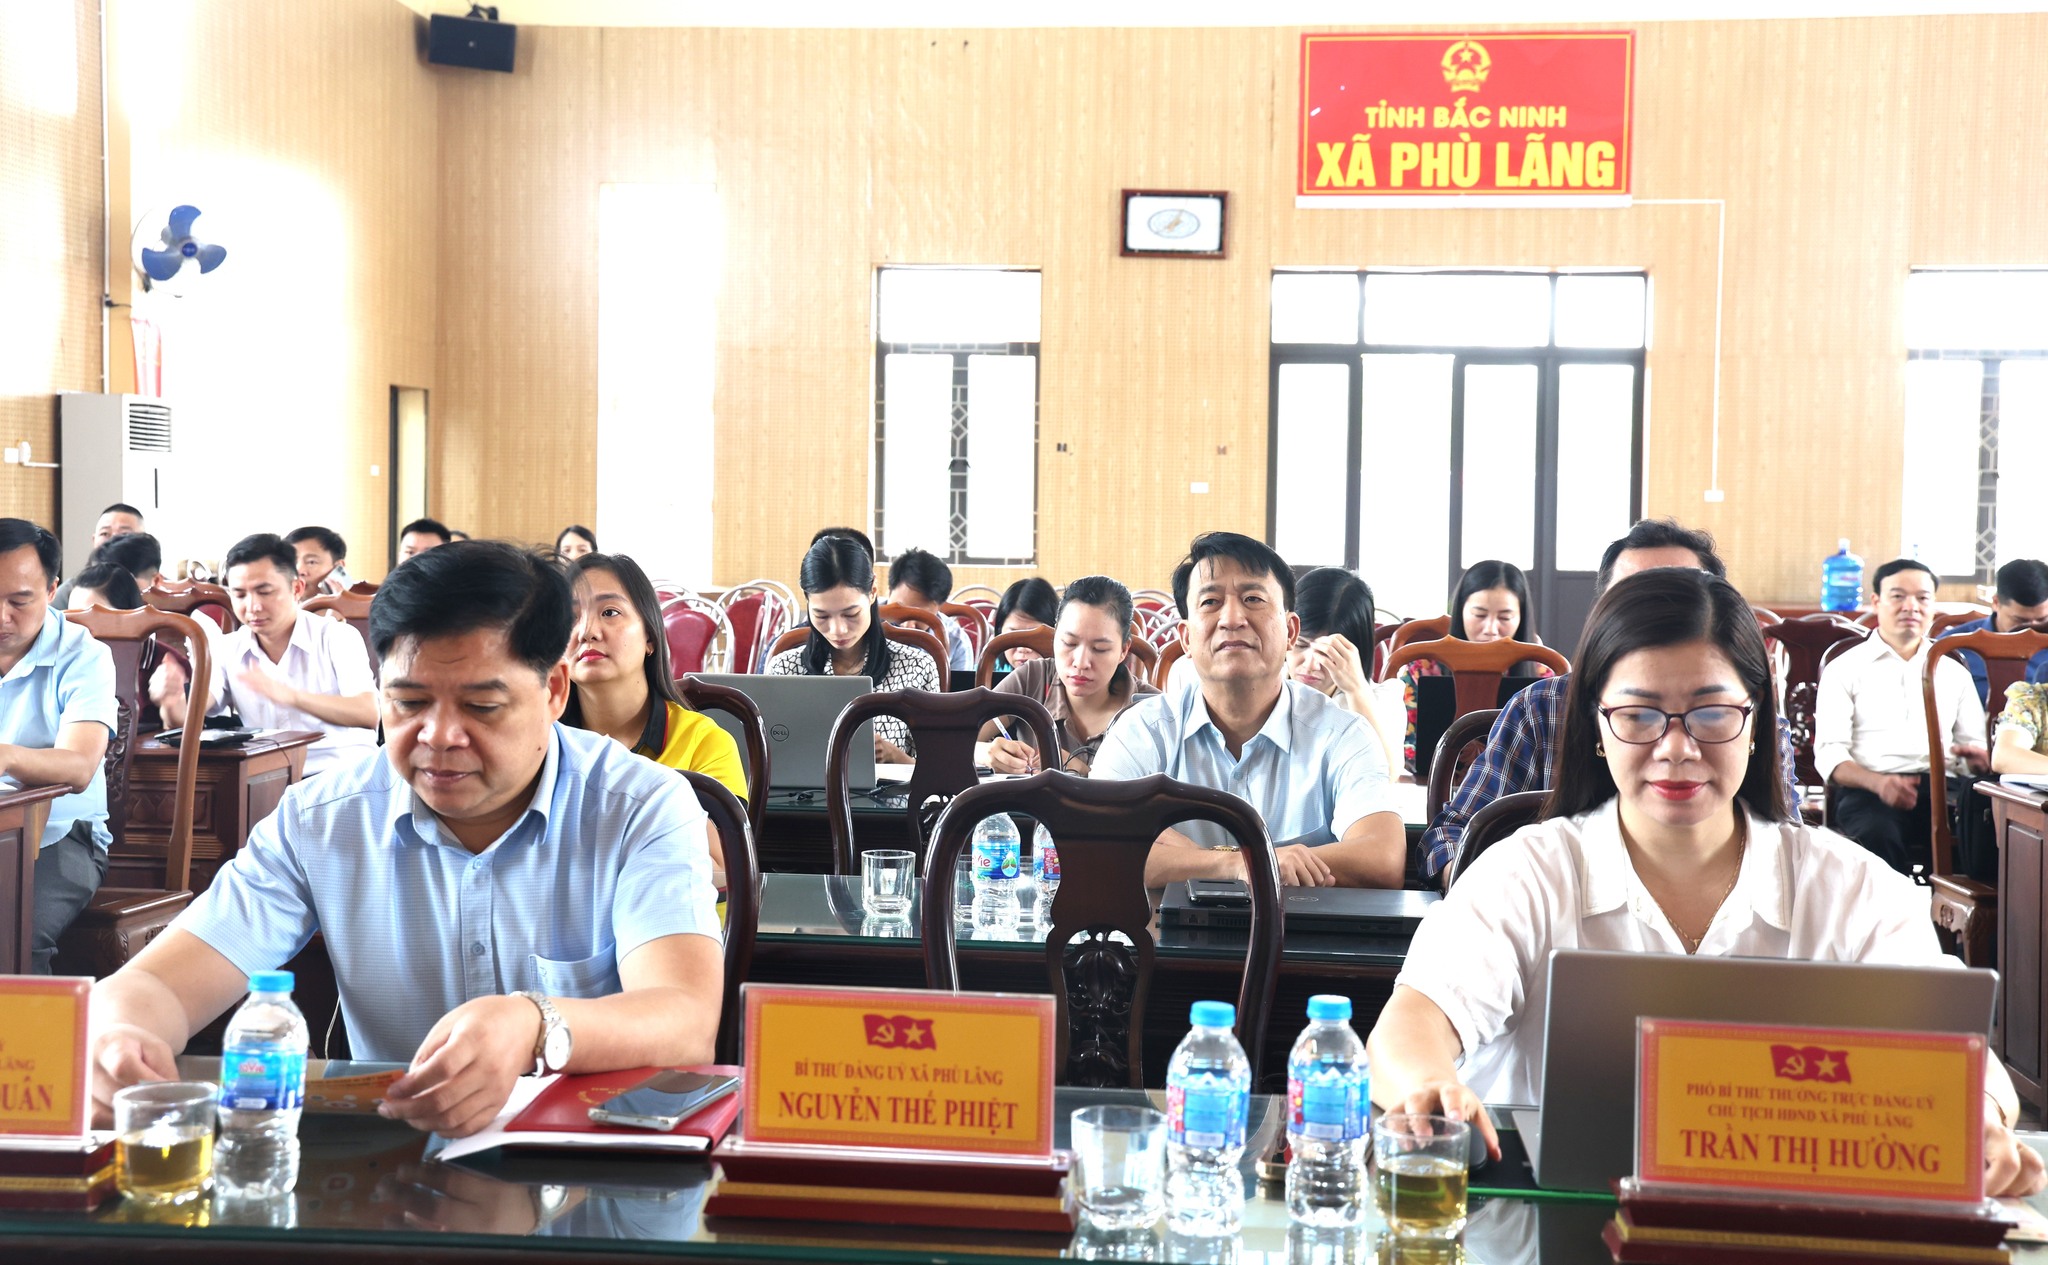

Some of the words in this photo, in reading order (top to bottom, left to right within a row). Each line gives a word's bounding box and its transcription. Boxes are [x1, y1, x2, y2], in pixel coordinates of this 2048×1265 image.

[1365, 99, 1425, 128] TỈNH
[1433, 96, 1491, 128] BẮC
[1499, 106, 1567, 128] NINH
[1315, 133, 1376, 187] XÃ
[1390, 132, 1481, 187] PHÙ
[1495, 132, 1616, 187] LÃNG
[795, 1058, 808, 1077] BÍ
[812, 1060, 842, 1078] THƯ
[910, 1063, 929, 1082] XÃ
[0, 1076, 54, 1111] UÂN
[1686, 1081, 1715, 1097] PHÓ
[1719, 1081, 1732, 1098] BÍ
[1736, 1085, 1766, 1099] THƯ
[778, 1086, 881, 1122] NGUYỄN
[887, 1089, 937, 1126] THẾ
[945, 1097, 1019, 1136] PHIỆT
[1741, 1105, 1774, 1122] TỊCH
[1680, 1122, 1759, 1161] TRẦN
[1768, 1134, 1819, 1173] THỊ
[1829, 1132, 1940, 1175] HƯỜNG
